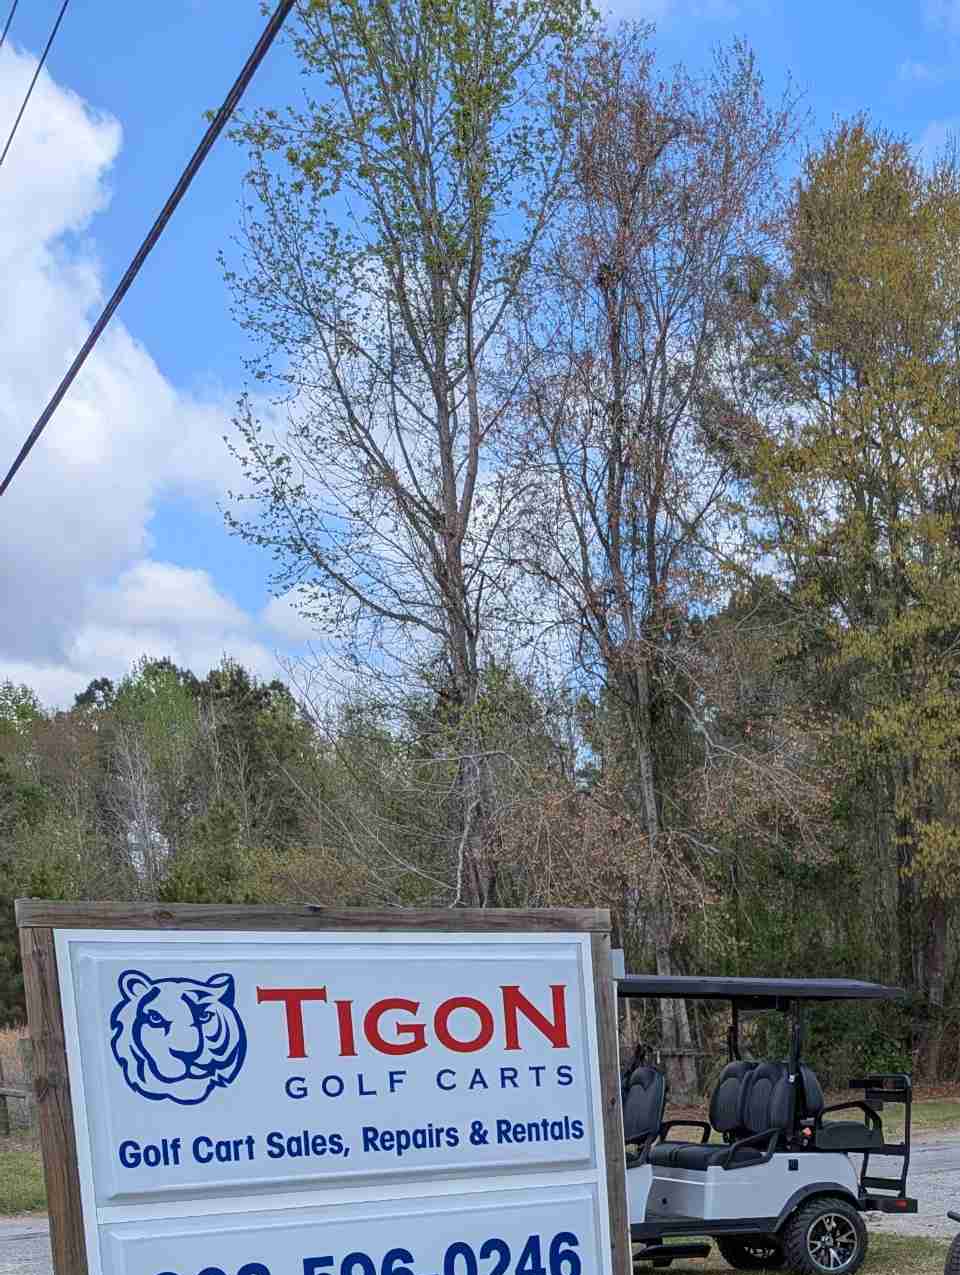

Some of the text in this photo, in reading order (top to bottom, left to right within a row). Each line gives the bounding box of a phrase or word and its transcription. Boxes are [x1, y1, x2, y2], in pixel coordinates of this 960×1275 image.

[256, 984, 570, 1058] TIGON
[284, 1065, 574, 1100] GOLF CARTS
[118, 1115, 585, 1169] Golf Cart Sales, Repairs & Rentals
